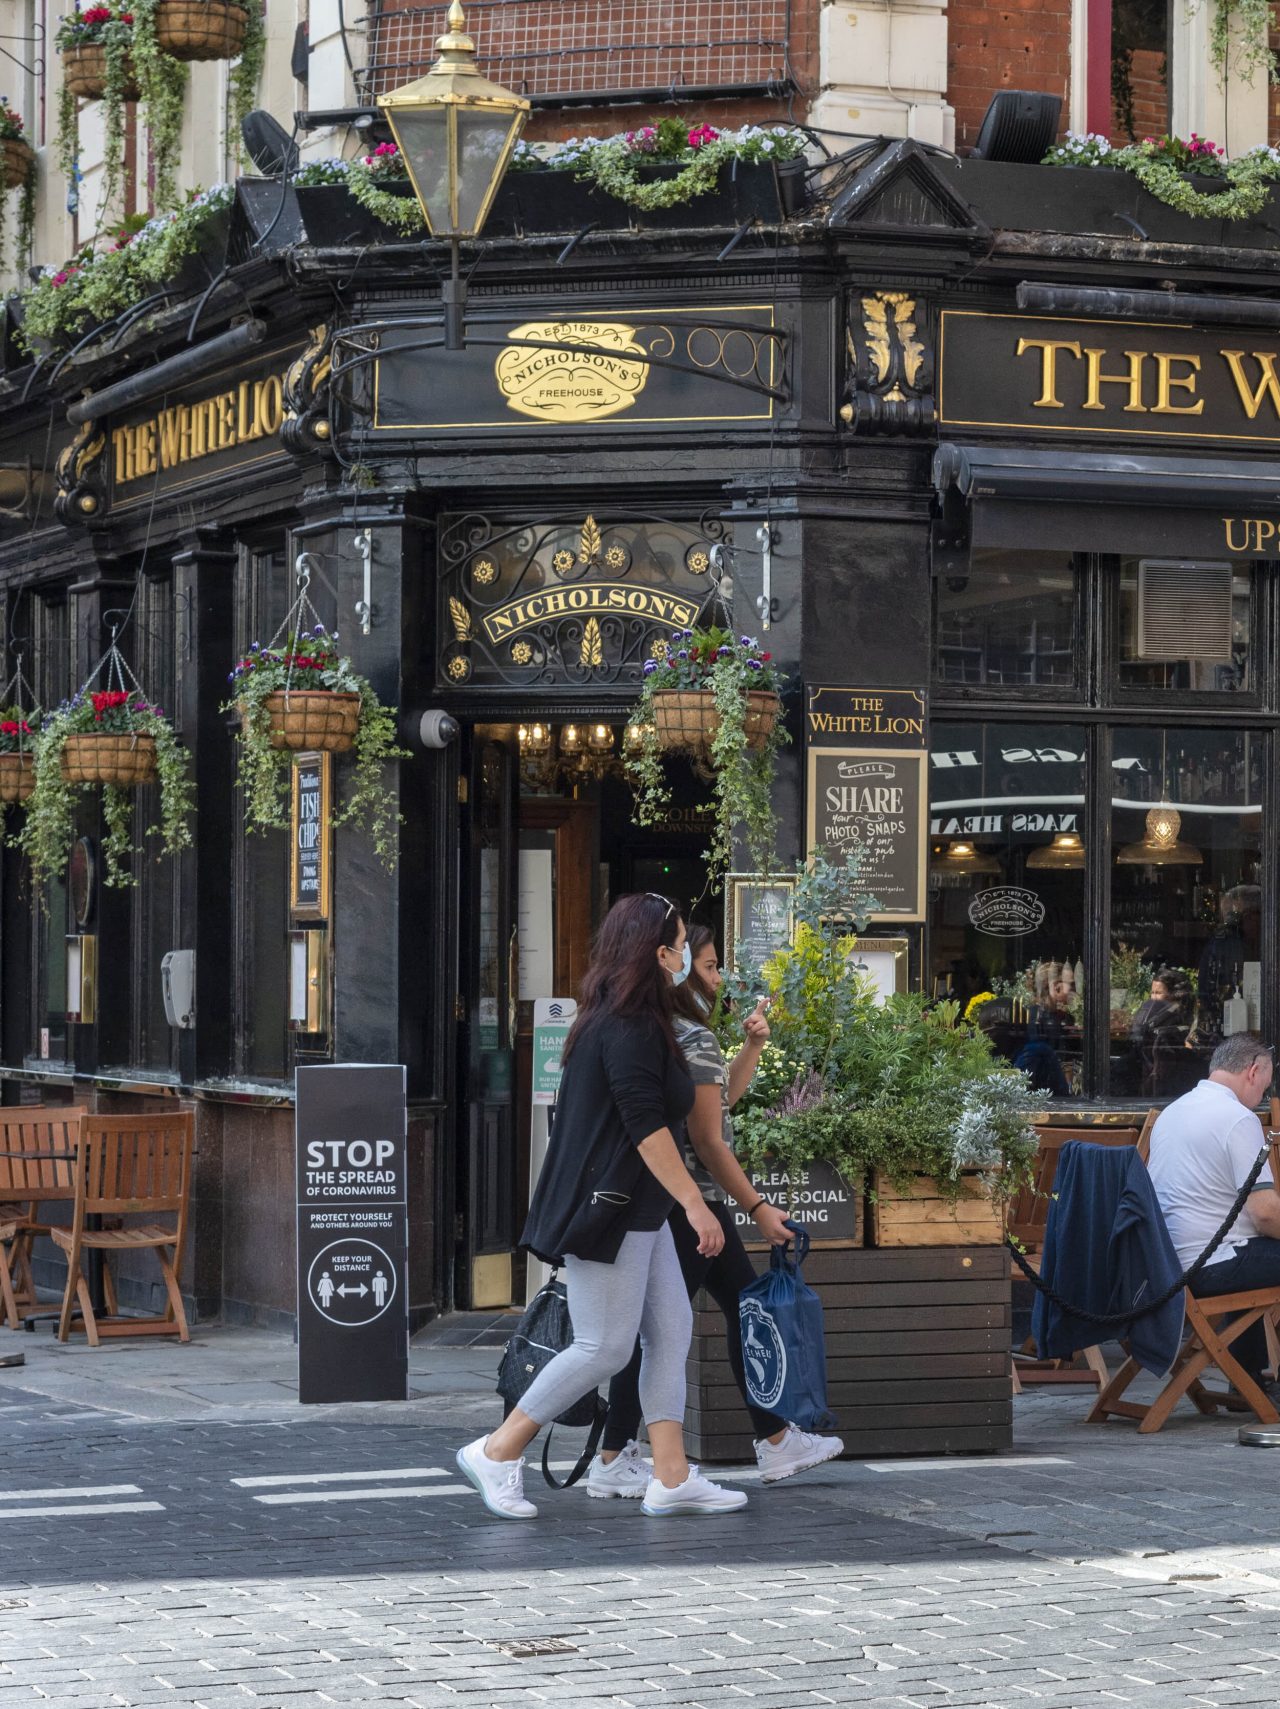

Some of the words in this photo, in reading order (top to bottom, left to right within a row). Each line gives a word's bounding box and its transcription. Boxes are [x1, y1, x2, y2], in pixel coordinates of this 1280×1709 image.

[574, 324, 600, 335] 1873
[514, 351, 630, 384] NICHOLSON'S
[1017, 337, 1204, 415] THE
[539, 388, 604, 398] FREEHOUSE
[112, 420, 157, 484] THE
[158, 391, 235, 469] WHITE
[237, 375, 288, 443] LIO
[492, 588, 691, 635] NICHOLSON'S
[851, 697, 884, 711] THE
[808, 712, 872, 733] WHITE
[873, 715, 925, 734] LION
[847, 764, 885, 776] PLEASE
[825, 786, 904, 813] SHARE
[832, 814, 854, 824] your
[825, 825, 860, 841] PHOTO
[866, 820, 906, 837] SNAPS
[874, 846, 895, 856] pub
[978, 903, 1035, 919] NICHOLSON'S
[307, 1140, 395, 1168] STOP
[306, 1171, 335, 1184] THE
[338, 1170, 396, 1183] SPREAD
[752, 1172, 810, 1186] PLEASE
[306, 1187, 320, 1196] OF
[322, 1185, 397, 1196] CORONAVIRUS
[791, 1189, 847, 1204] SOCIAL
[310, 1213, 348, 1222] PROTECT
[350, 1212, 393, 1221] YOURSELF
[351, 1255, 372, 1263] YOUR
